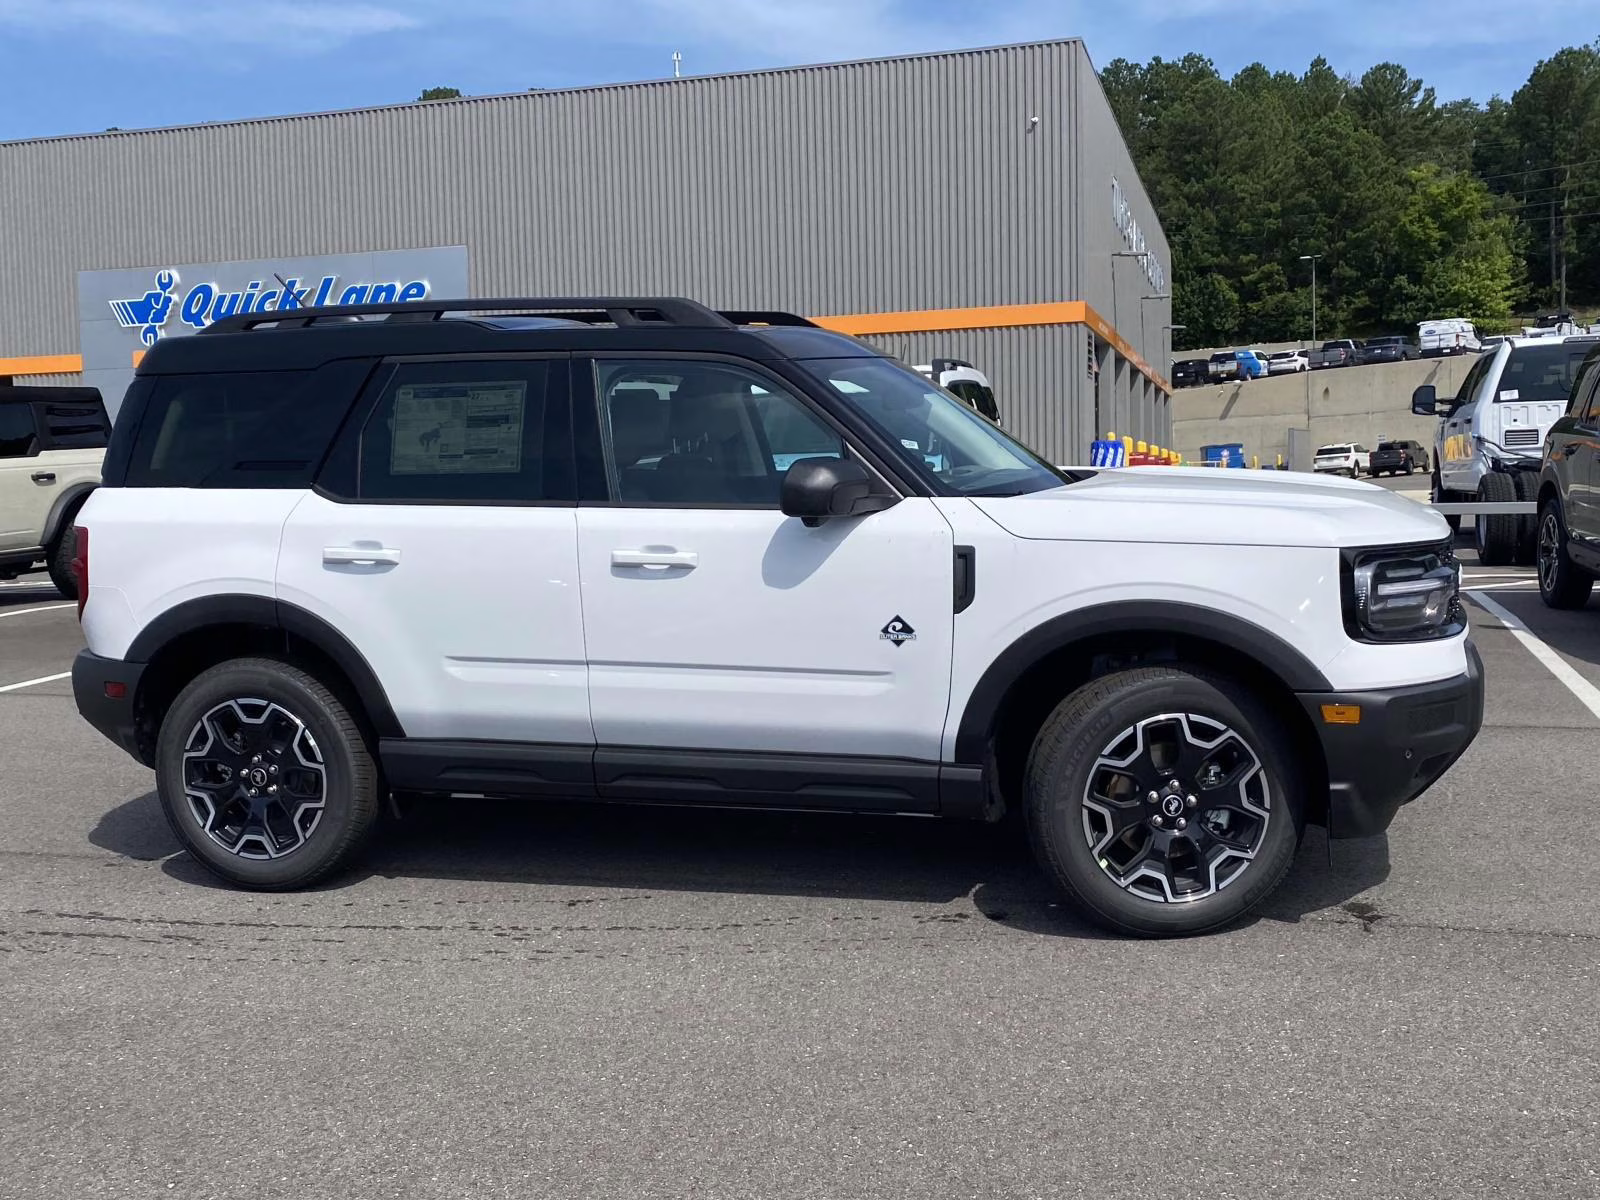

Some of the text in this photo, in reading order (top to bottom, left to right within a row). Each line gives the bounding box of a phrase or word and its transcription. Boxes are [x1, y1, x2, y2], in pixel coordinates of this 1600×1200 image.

[180, 275, 428, 328] Quick Lane
[1065, 712, 1113, 777] MICHELIN
